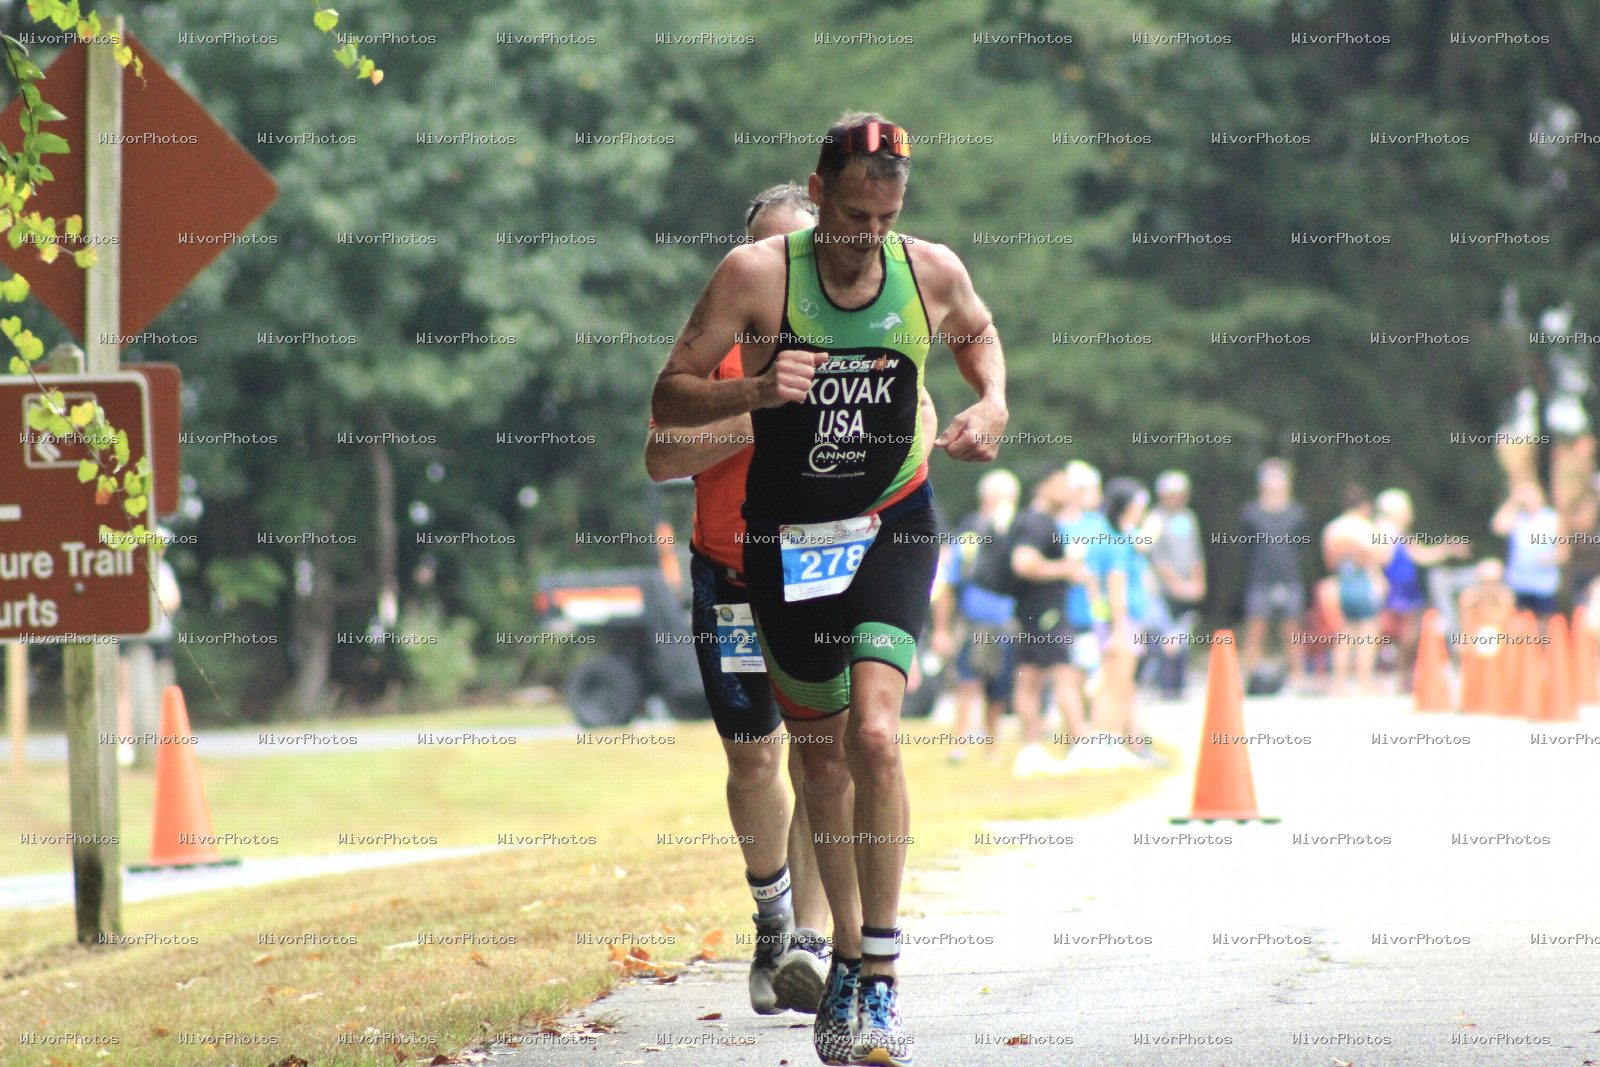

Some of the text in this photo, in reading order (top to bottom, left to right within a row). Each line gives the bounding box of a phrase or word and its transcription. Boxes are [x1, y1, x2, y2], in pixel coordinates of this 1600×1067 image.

[801, 376, 896, 405] KOVAK
[818, 409, 865, 438] USA
[808, 442, 867, 473] CANNON
[61, 541, 134, 577] Trail
[800, 544, 866, 580] 278
